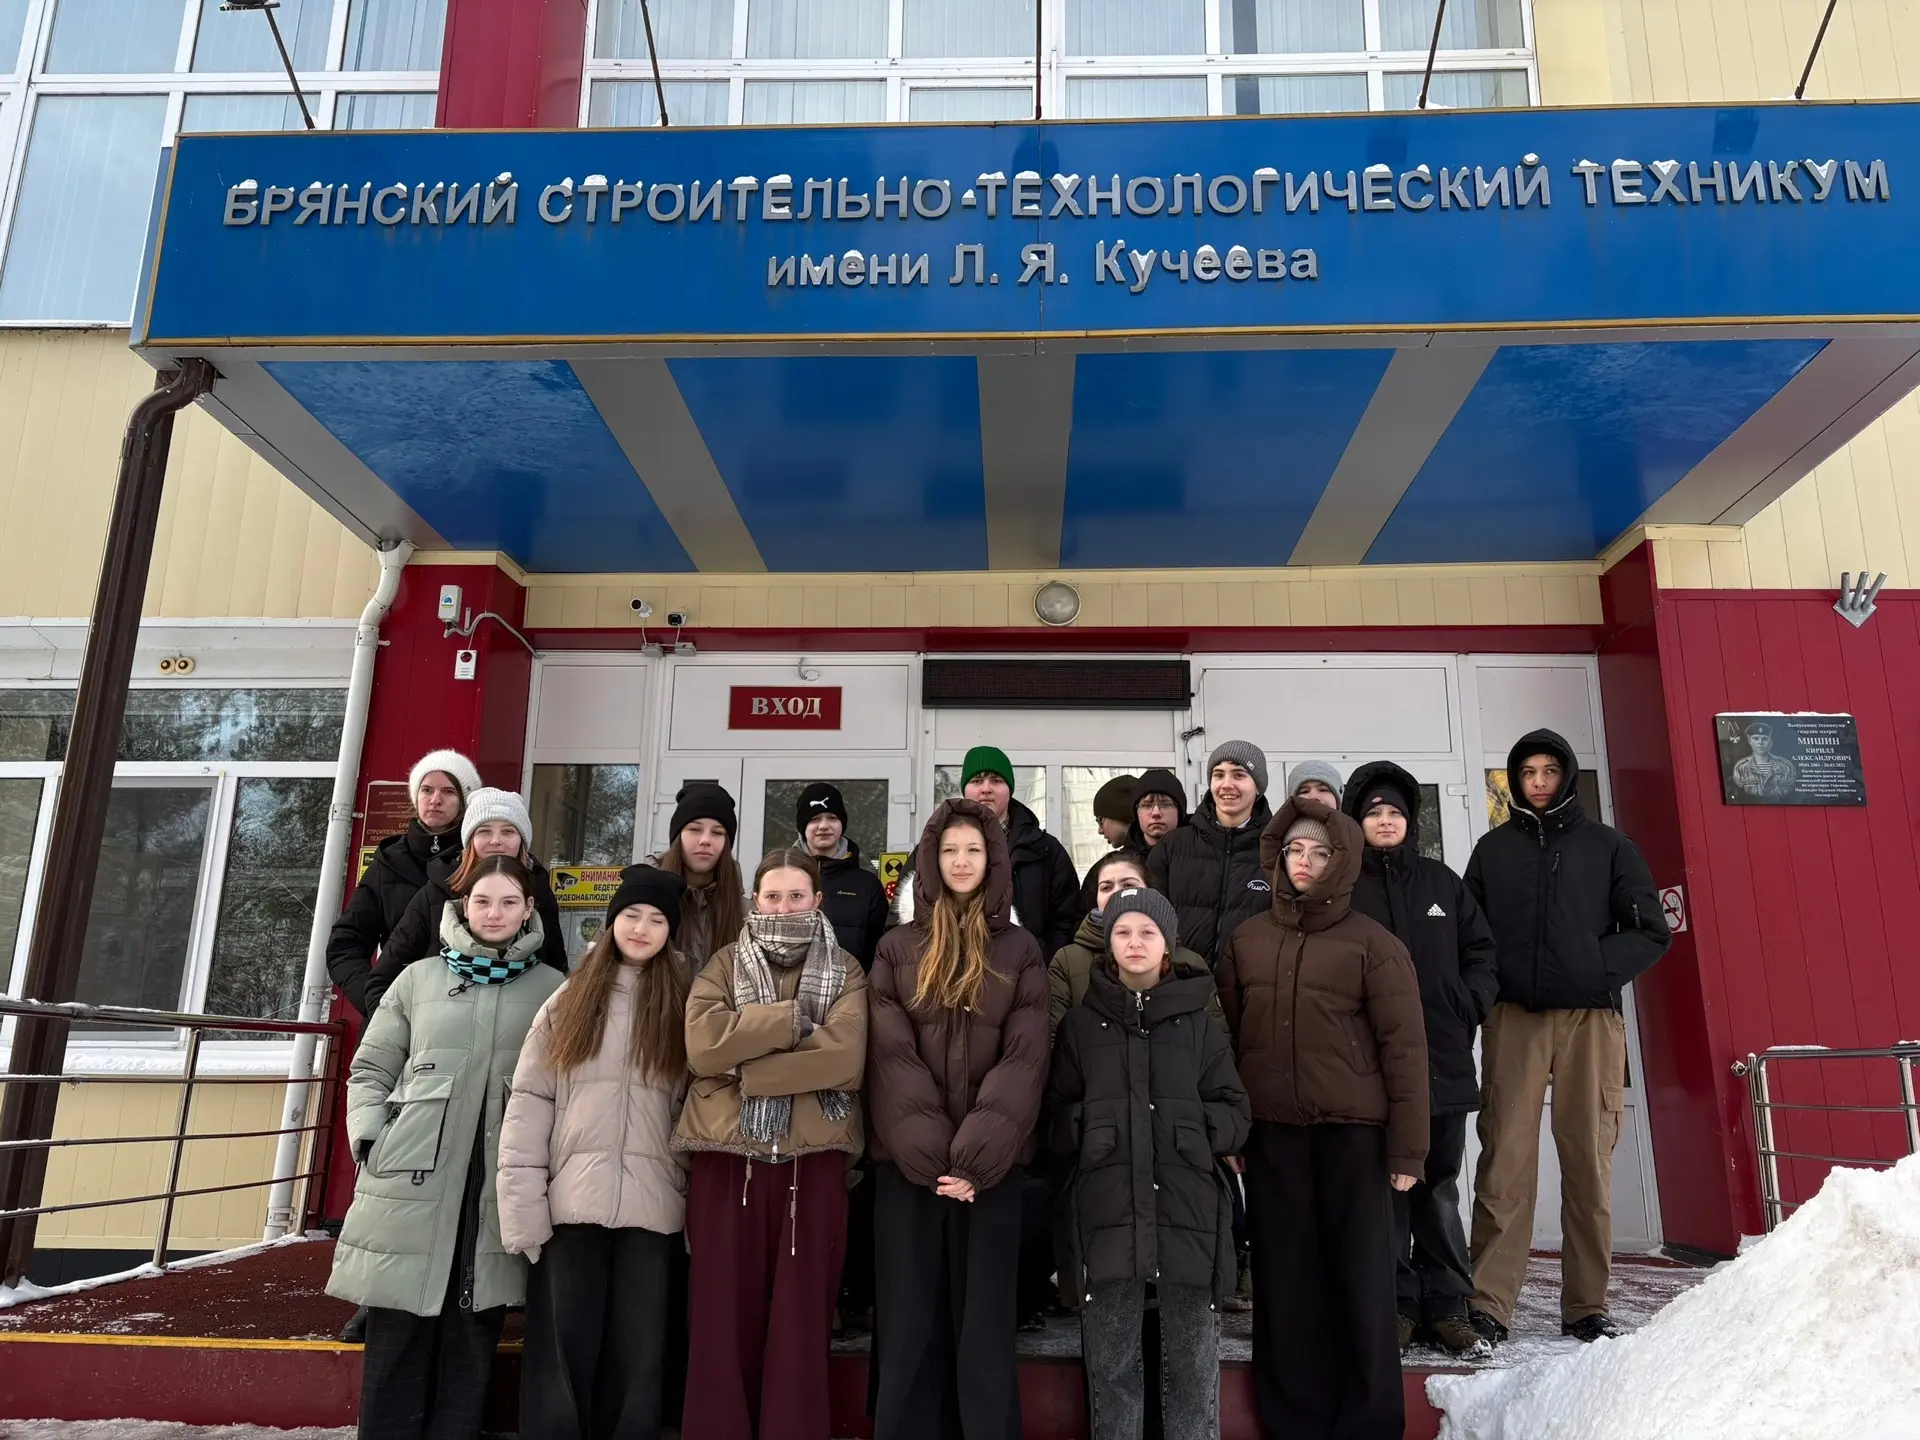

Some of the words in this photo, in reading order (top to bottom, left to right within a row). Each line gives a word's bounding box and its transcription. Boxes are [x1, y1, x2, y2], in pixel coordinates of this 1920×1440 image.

[223, 173, 518, 226] БРЯНСКИЙ
[1573, 160, 1890, 206] ТЕХНИКУМ
[768, 251, 929, 288] имени
[948, 243, 999, 285] Л.
[1017, 242, 1068, 285] Я.
[1095, 240, 1318, 293] Кучеева
[751, 697, 822, 719] ВХОД
[1797, 737, 1840, 745] МИШИН
[593, 884, 619, 892] ВЕДЕТС
